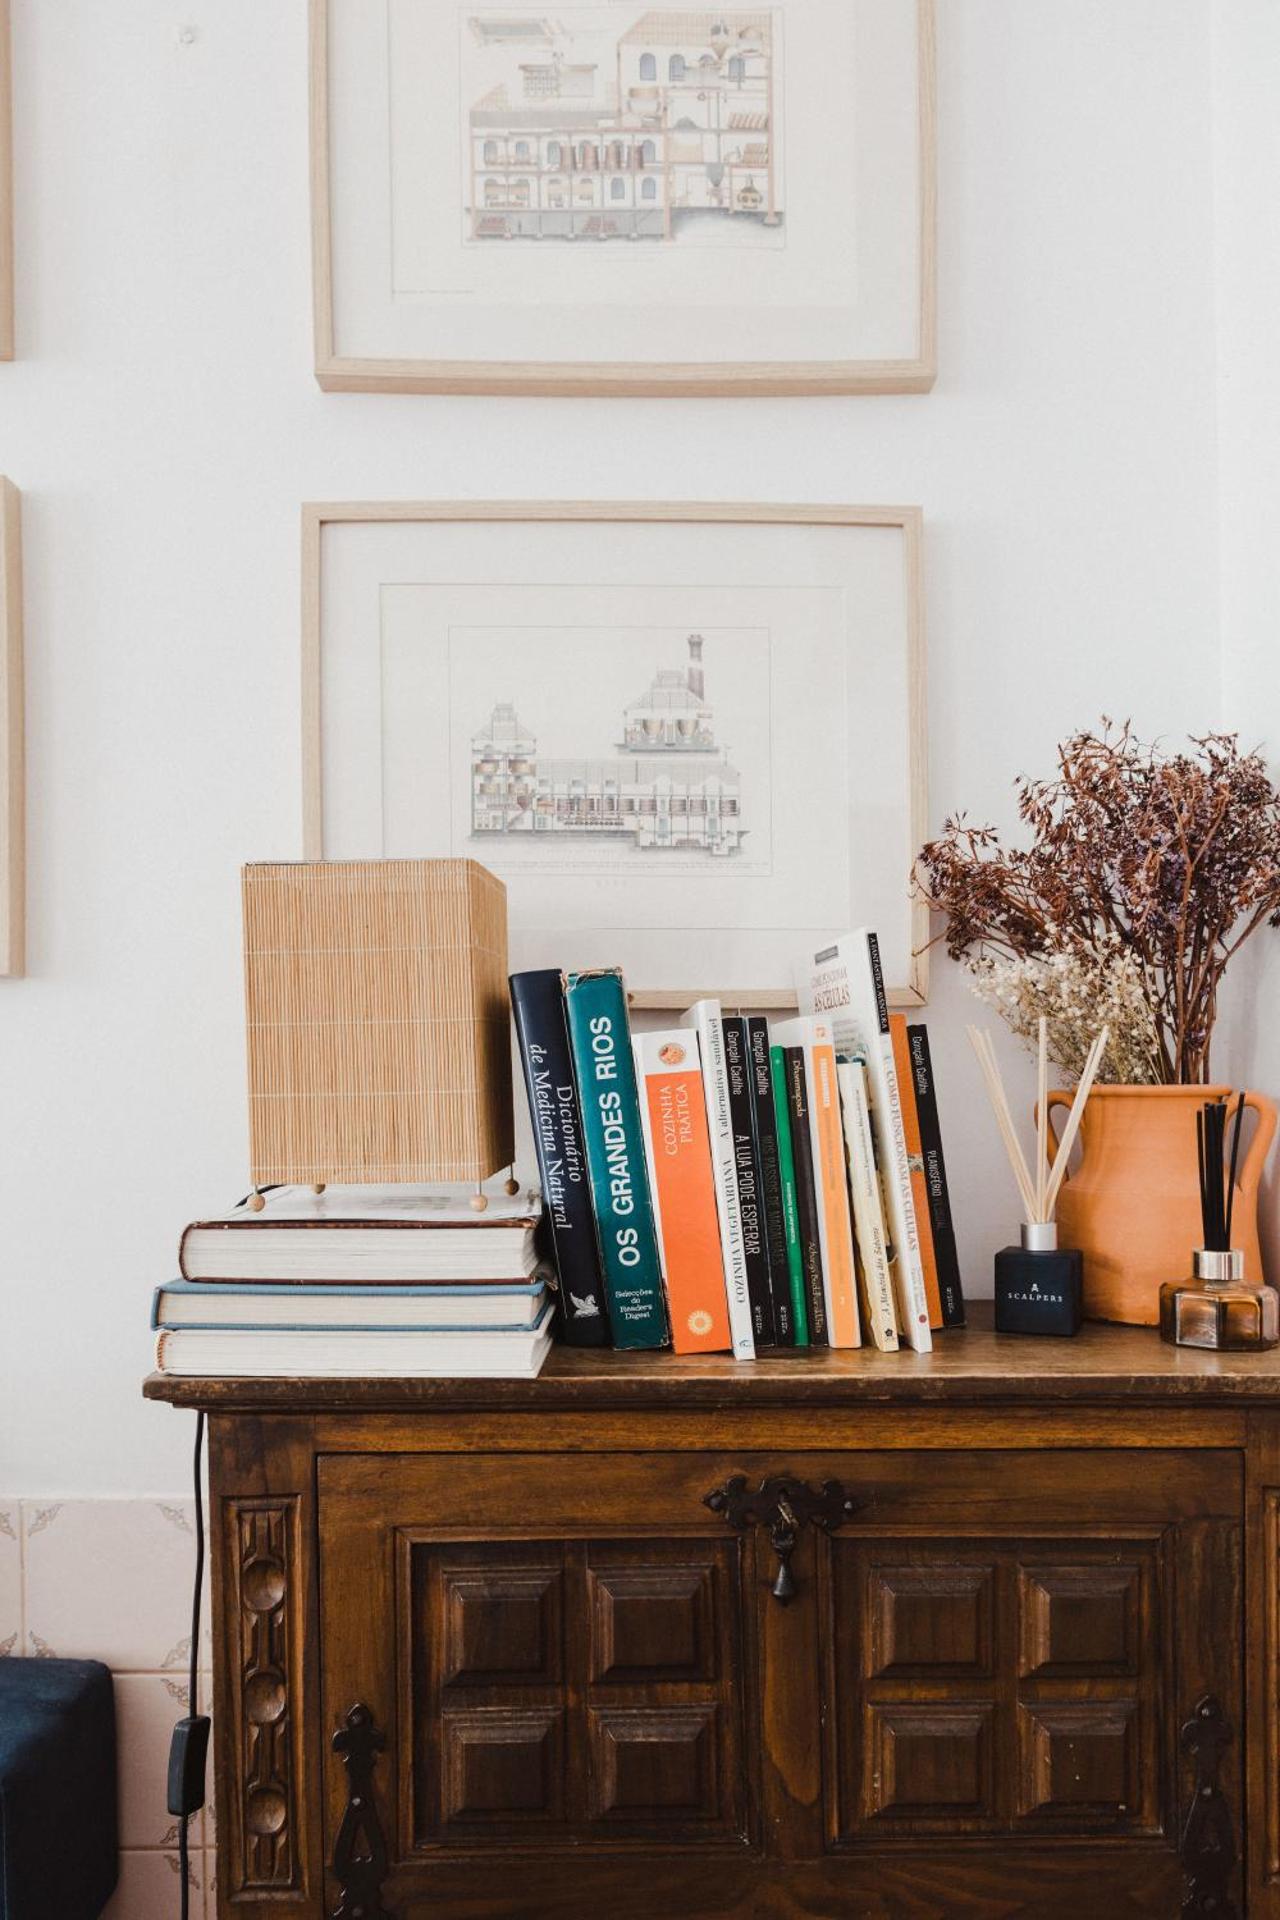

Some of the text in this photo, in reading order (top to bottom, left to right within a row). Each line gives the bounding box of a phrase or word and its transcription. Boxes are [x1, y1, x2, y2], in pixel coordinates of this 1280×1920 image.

[708, 1018, 730, 1139] A alternativa saudável
[726, 1031, 744, 1095] Gonçalo Cadilhe
[752, 1031, 770, 1095] Gonçalo Cadilhe
[911, 1036, 924, 1066] Gonçalo
[529, 1044, 573, 1230] de Medicina Natural
[556, 1086, 585, 1183] Dicionário
[589, 1016, 641, 1267] OS GRANDES RIOS
[659, 1085, 678, 1157] COZINHA
[722, 1159, 746, 1304] COZINHA VEGETARIANA
[735, 1134, 761, 1255] A LUA PODE ESPERAR
[624, 1312, 651, 1321] Digest
[1007, 1291, 1063, 1303] SCALPERS
